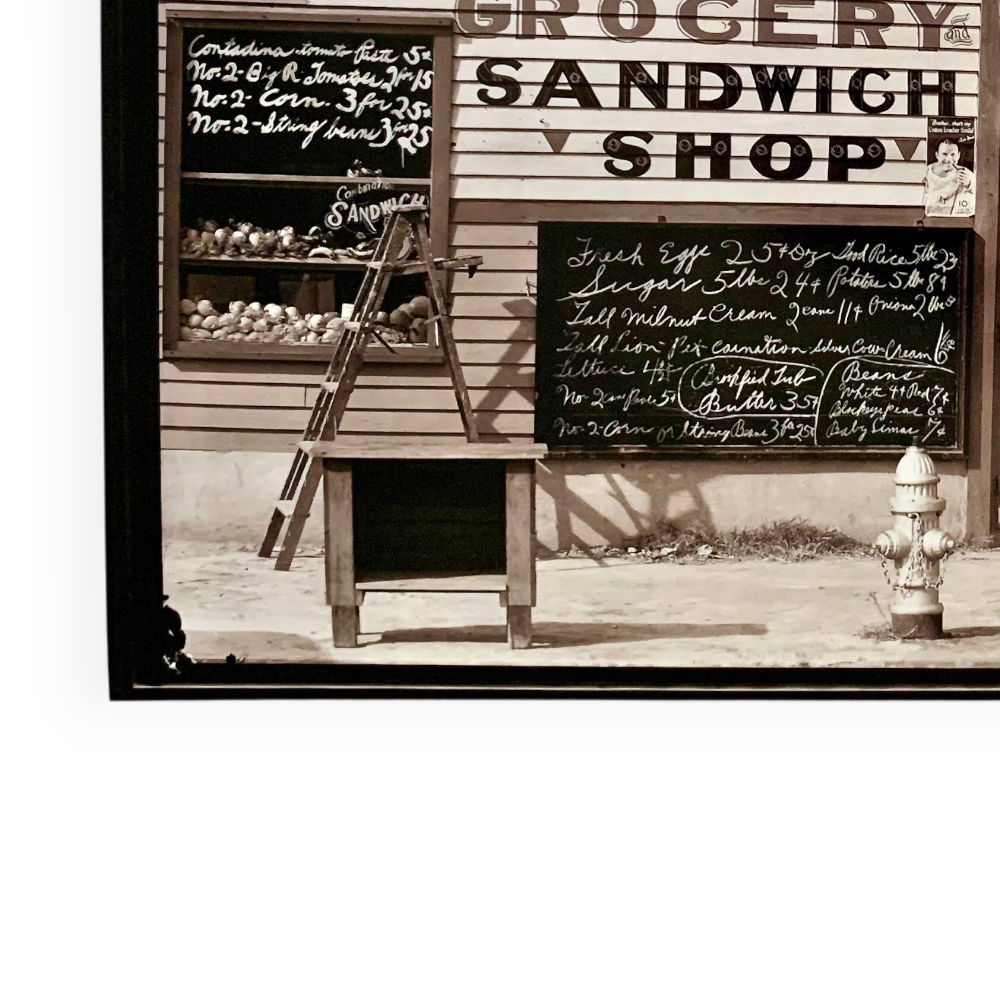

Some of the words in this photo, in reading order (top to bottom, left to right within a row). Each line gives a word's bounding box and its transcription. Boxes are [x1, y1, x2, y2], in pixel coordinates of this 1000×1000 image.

[944, 22, 971, 41] and
[335, 87, 358, 113] 3
[354, 92, 393, 119] for
[476, 57, 956, 117] SANDWICH
[604, 131, 886, 182] SHOP
[567, 237, 645, 268] Fresh
[659, 241, 712, 275] Eggs
[556, 263, 703, 303] Sugar
[566, 299, 617, 329] Tall
[708, 303, 777, 323] Cream
[841, 360, 925, 383] Beans
[699, 388, 777, 415] Butter
